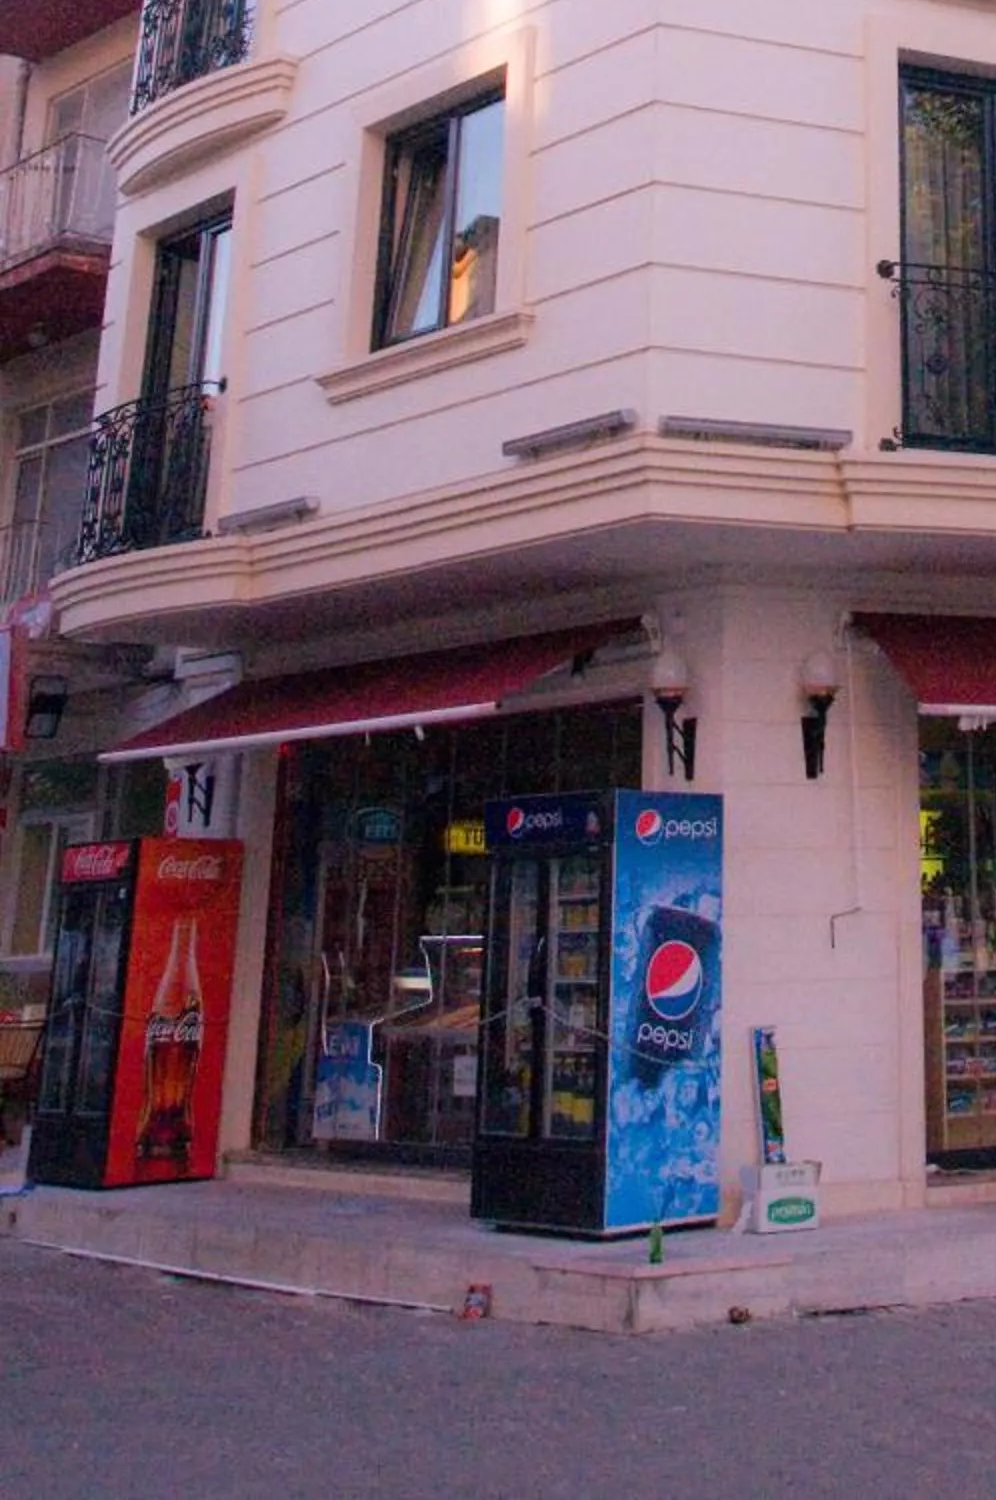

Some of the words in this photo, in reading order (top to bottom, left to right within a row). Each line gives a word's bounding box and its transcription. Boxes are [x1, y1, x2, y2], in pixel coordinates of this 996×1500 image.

[524, 811, 562, 832] pepsi
[664, 816, 718, 840] pepsi
[637, 1022, 694, 1051] pepsi
